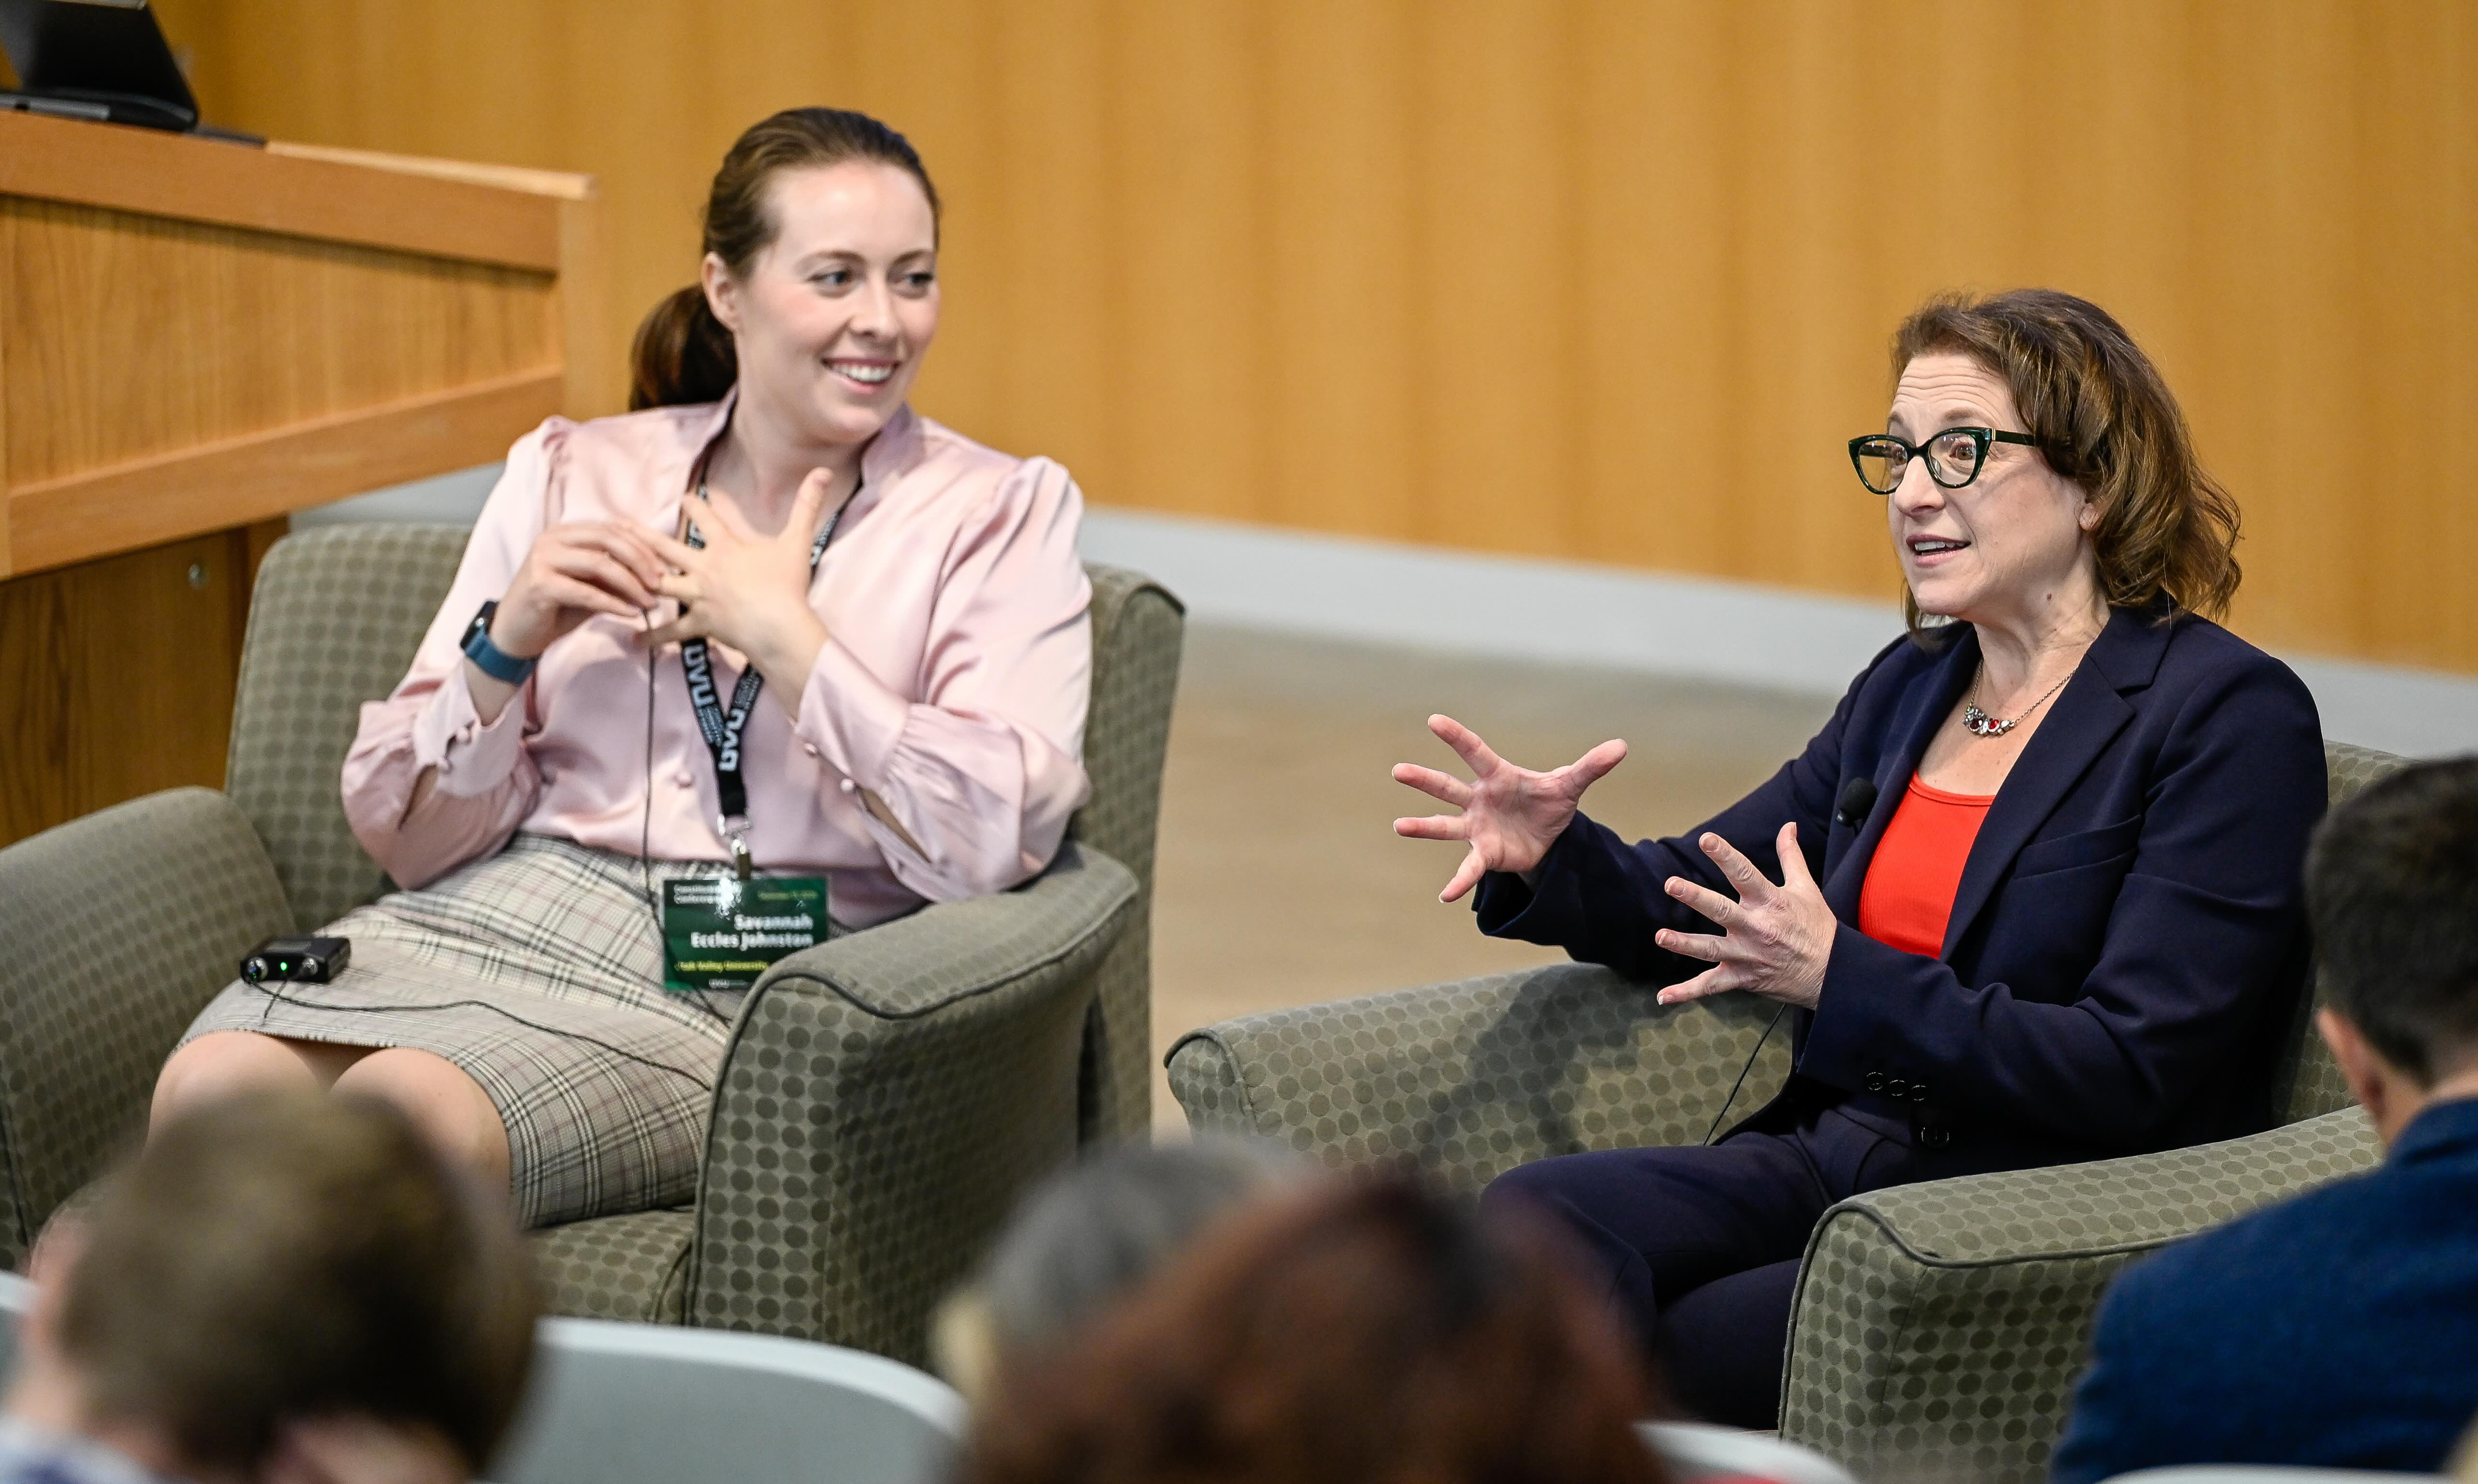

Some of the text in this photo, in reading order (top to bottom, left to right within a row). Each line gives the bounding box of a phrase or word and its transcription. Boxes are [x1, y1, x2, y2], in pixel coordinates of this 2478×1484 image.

[684, 644, 715, 707] UVU
[718, 708, 746, 771] UVU
[691, 931, 814, 952] Eccles Johnston
[735, 914, 814, 930] Savannah
